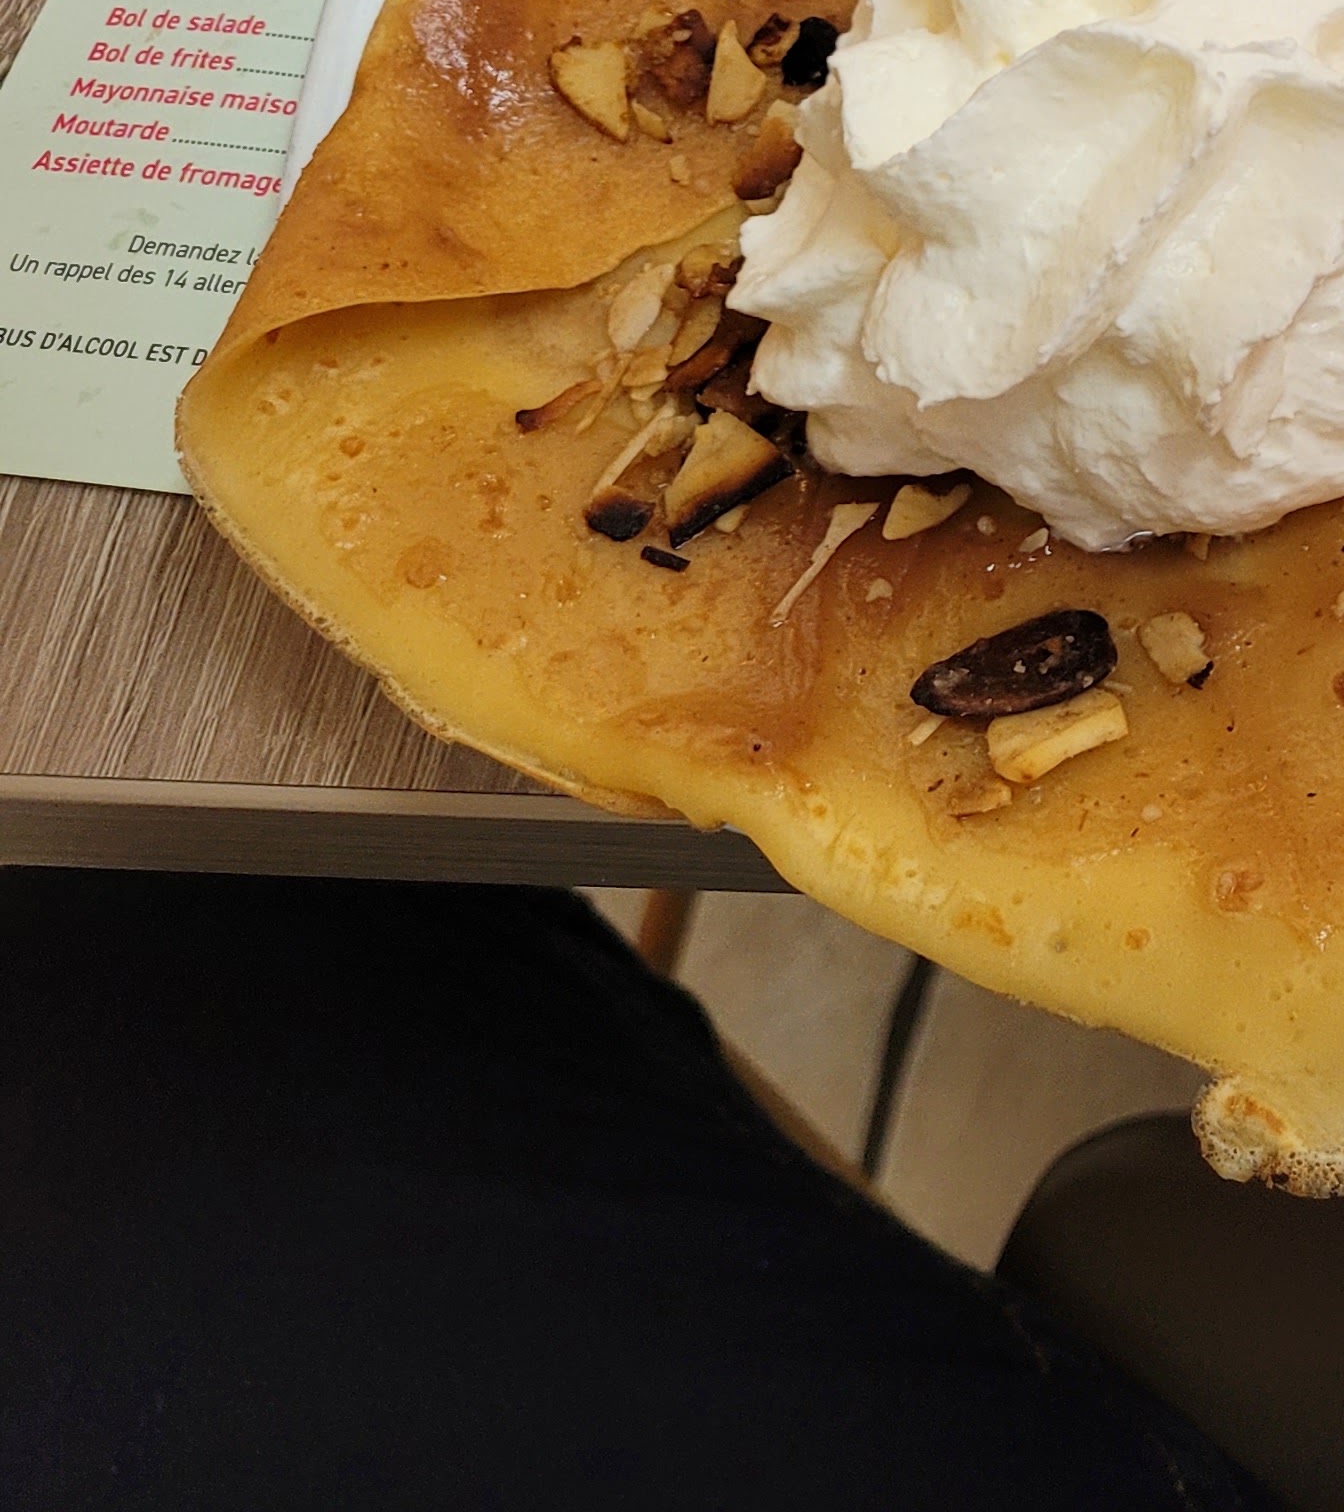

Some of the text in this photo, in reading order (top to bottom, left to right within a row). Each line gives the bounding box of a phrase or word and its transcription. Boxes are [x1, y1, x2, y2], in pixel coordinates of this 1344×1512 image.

[105, 7, 267, 36] Bol de salade
[88, 42, 237, 71] Bol de frites
[69, 77, 298, 116] Mayonnaise maiso
[51, 113, 170, 142] Moutarde
[32, 150, 135, 178] Assiette
[141, 159, 172, 181] de
[128, 234, 242, 265] Demandez
[9, 253, 40, 274] Un
[43, 259, 111, 284] rappel
[117, 264, 156, 286] des
[164, 268, 188, 289] 14
[40, 332, 190, 367] D'ALCOOL EST
